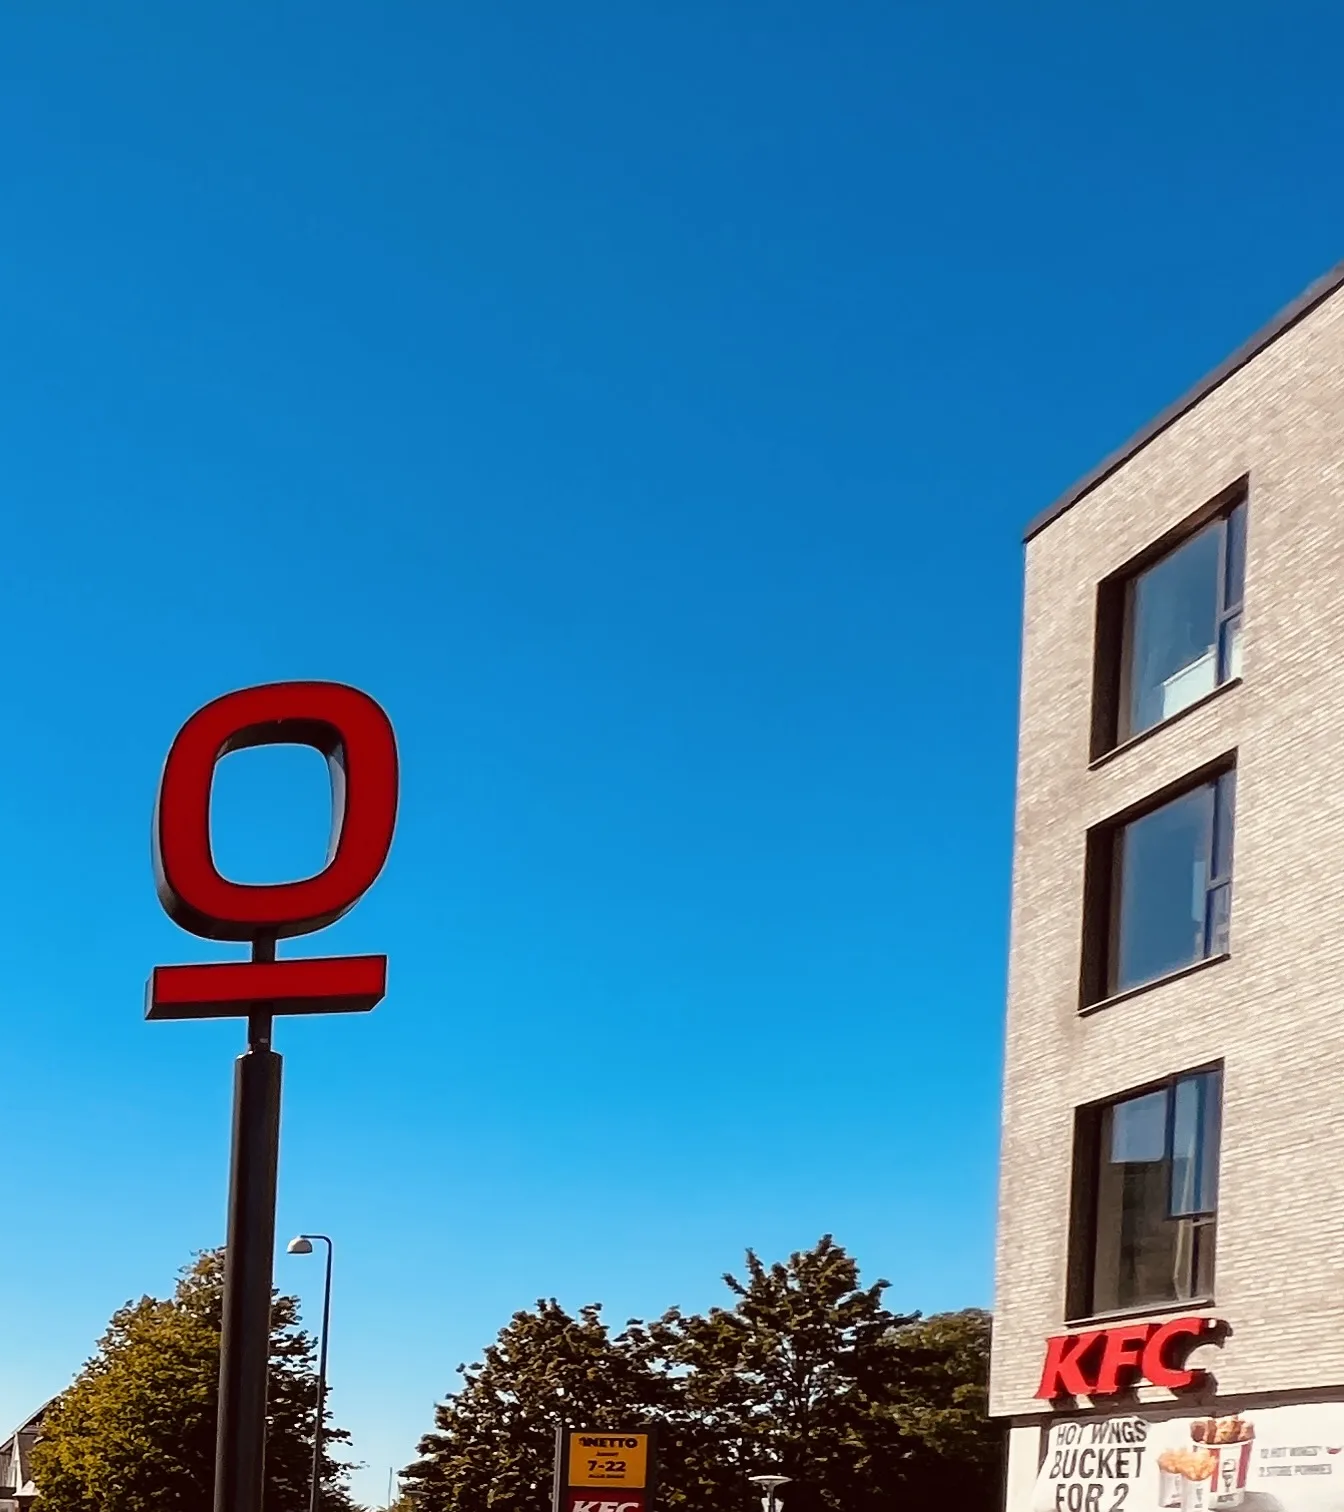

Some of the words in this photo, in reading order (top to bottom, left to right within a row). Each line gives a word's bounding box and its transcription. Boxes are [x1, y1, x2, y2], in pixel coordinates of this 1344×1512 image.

[1033, 1317, 1202, 1399] KFC
[587, 1437, 638, 1449] NETTO
[587, 1460, 627, 1472] 7-22
[1049, 1446, 1146, 1479] BUCKET
